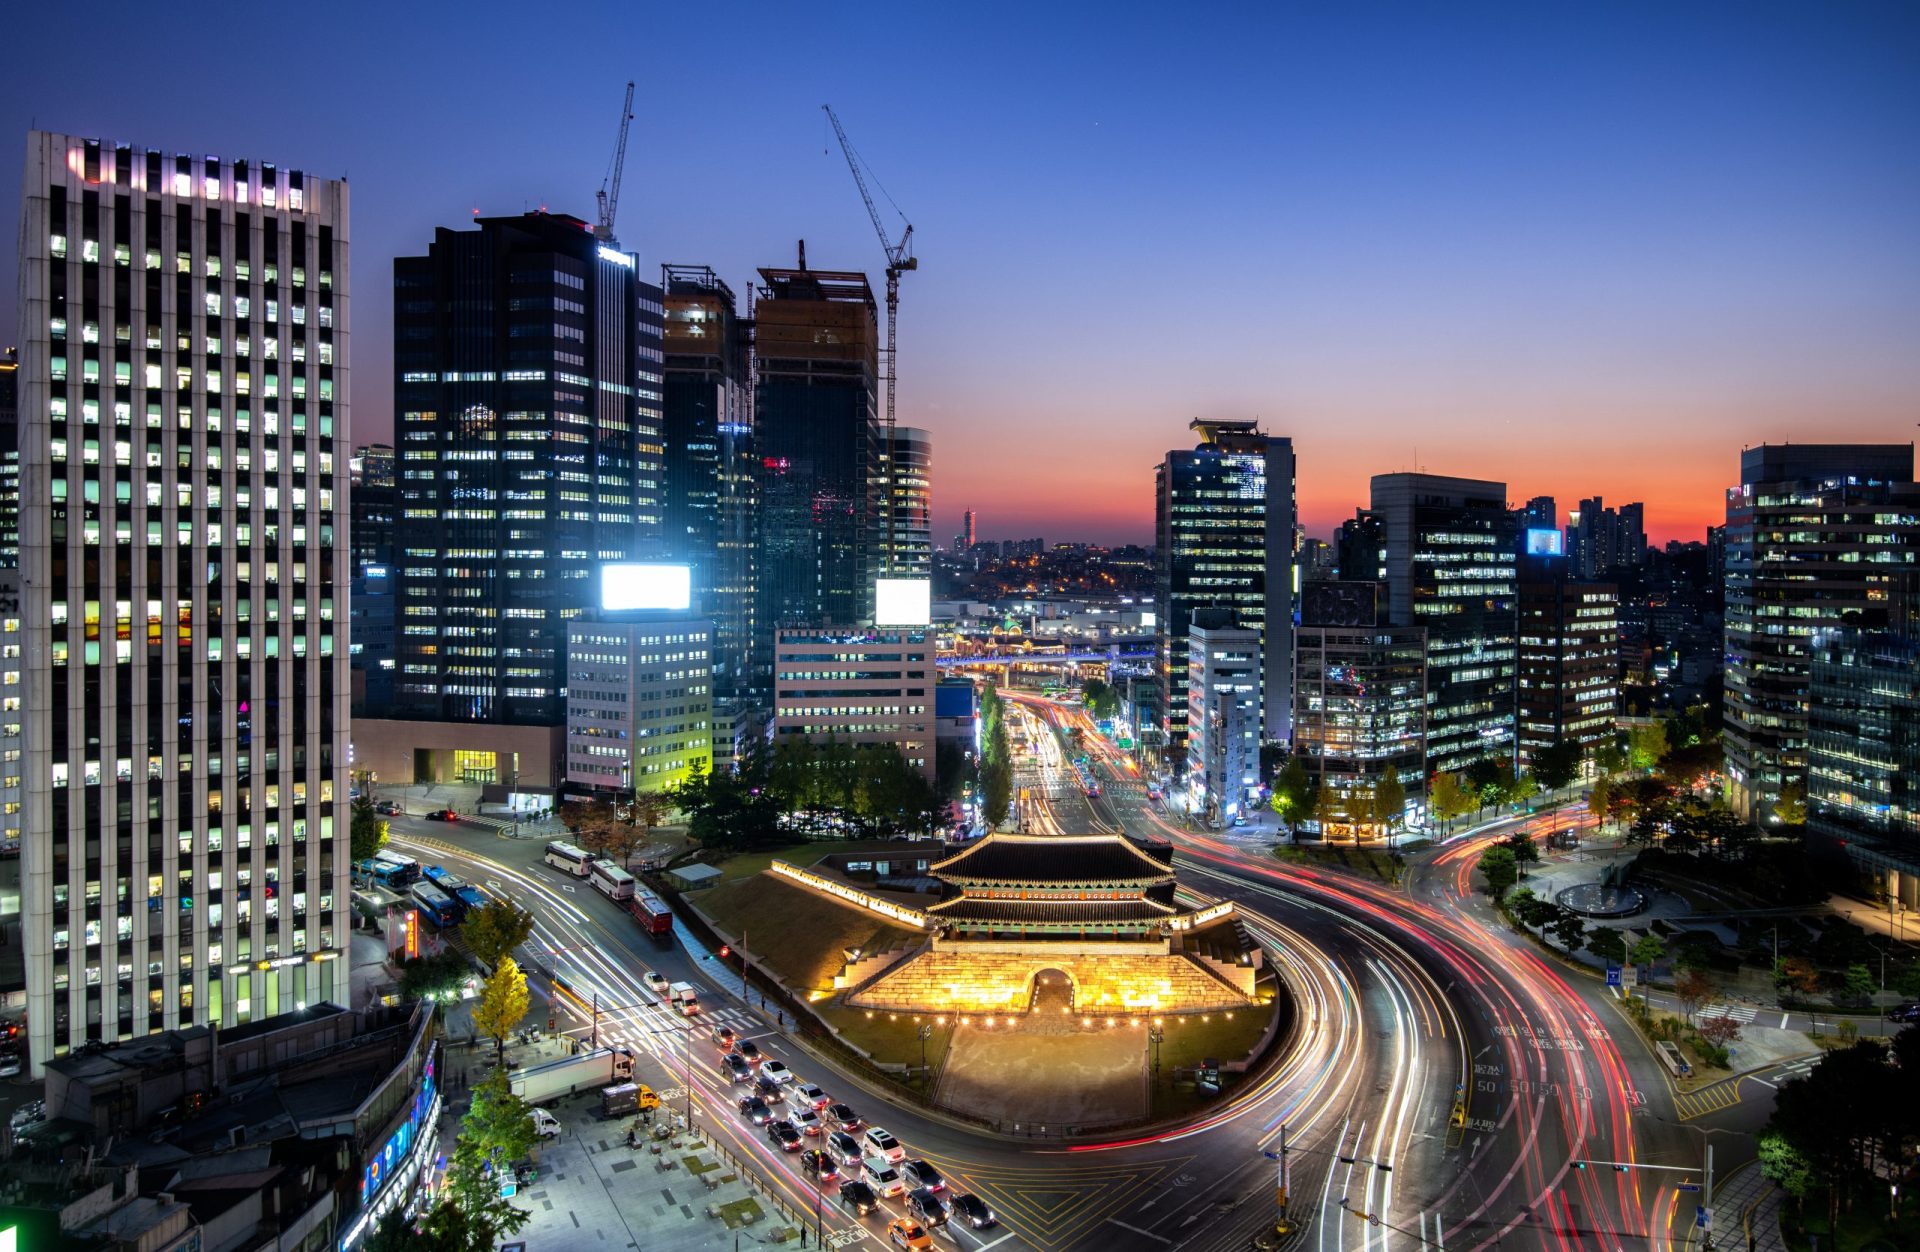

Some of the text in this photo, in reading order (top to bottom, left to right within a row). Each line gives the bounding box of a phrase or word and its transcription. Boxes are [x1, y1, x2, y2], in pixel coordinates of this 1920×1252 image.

[1477, 1080, 1496, 1093] 50
[1510, 1080, 1529, 1094] 50
[1540, 1084, 1559, 1097] 50
[1575, 1087, 1593, 1100] 50
[1625, 1090, 1647, 1104] 50
